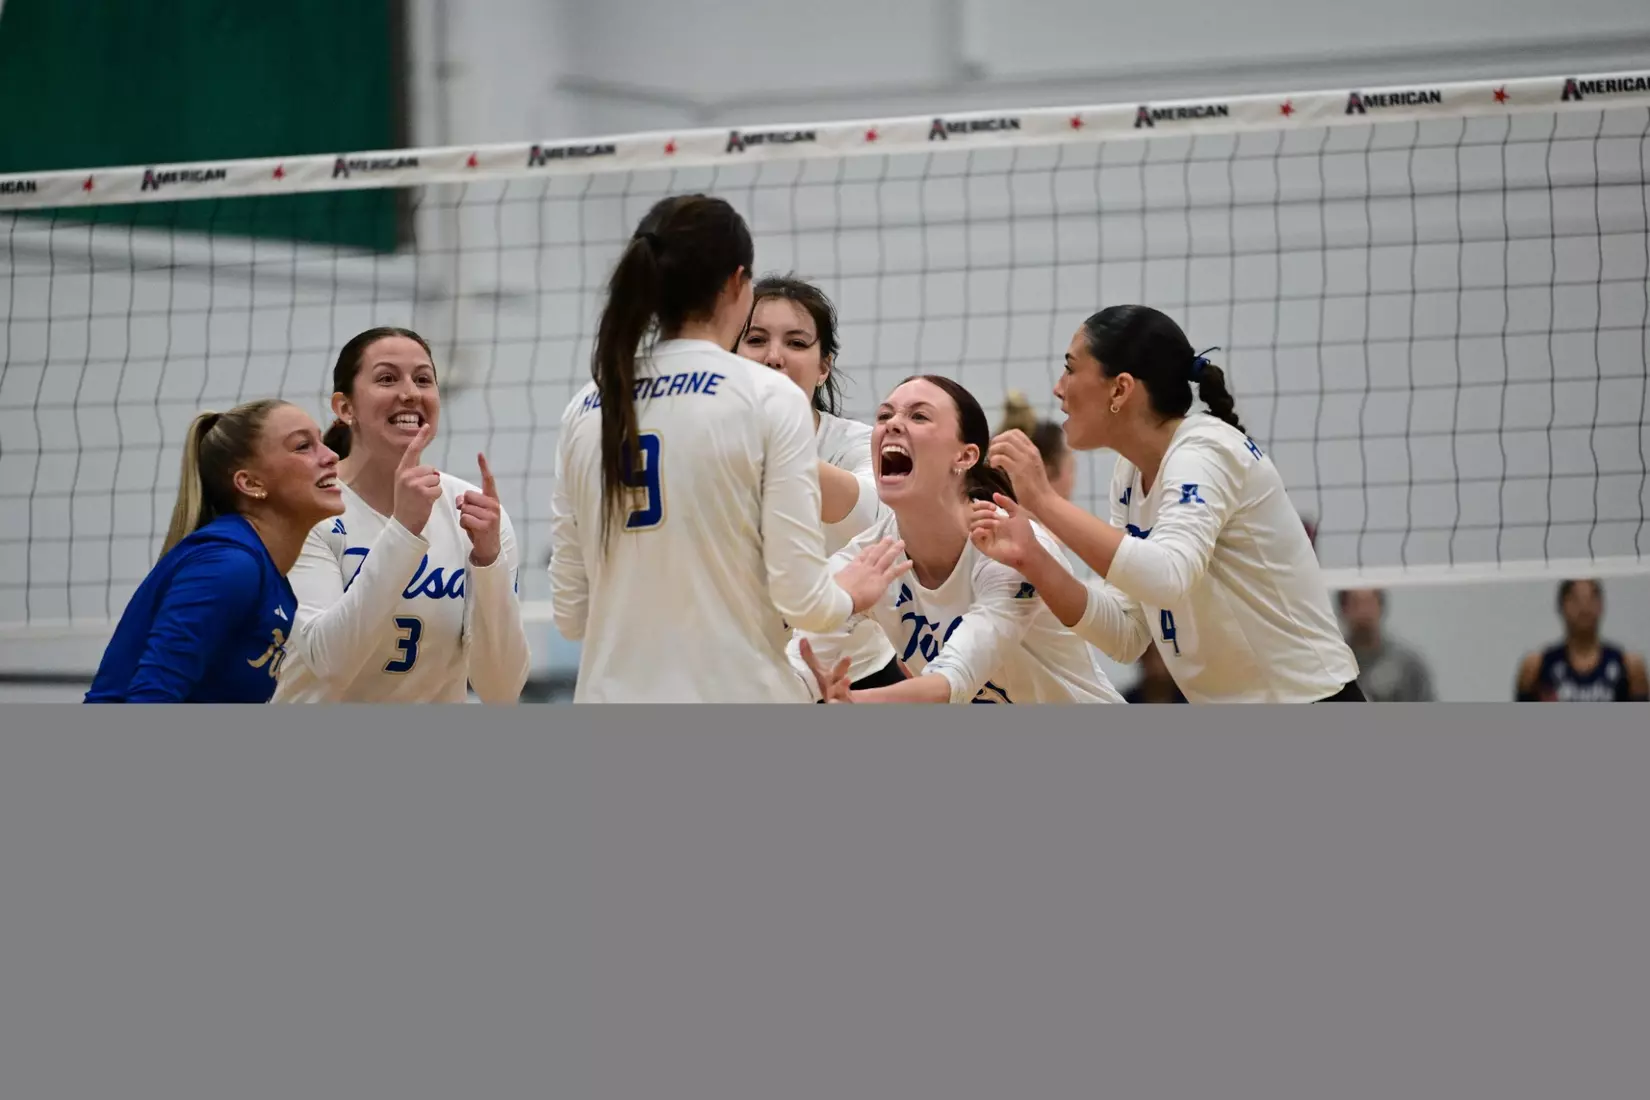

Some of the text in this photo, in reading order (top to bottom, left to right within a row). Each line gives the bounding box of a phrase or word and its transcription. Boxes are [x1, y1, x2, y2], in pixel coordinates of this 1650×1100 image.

[141, 168, 227, 191] AMERICAN
[332, 157, 419, 178] AMERICAN
[527, 145, 616, 168] AMERICAN
[928, 118, 1020, 141] AMERICAN
[1134, 104, 1229, 128] AMERICAN
[1345, 90, 1441, 115] AMERICAN
[619, 430, 667, 532] 9
[343, 547, 464, 599] Tlsa
[382, 614, 424, 673] 3
[1161, 609, 1180, 656] 4
